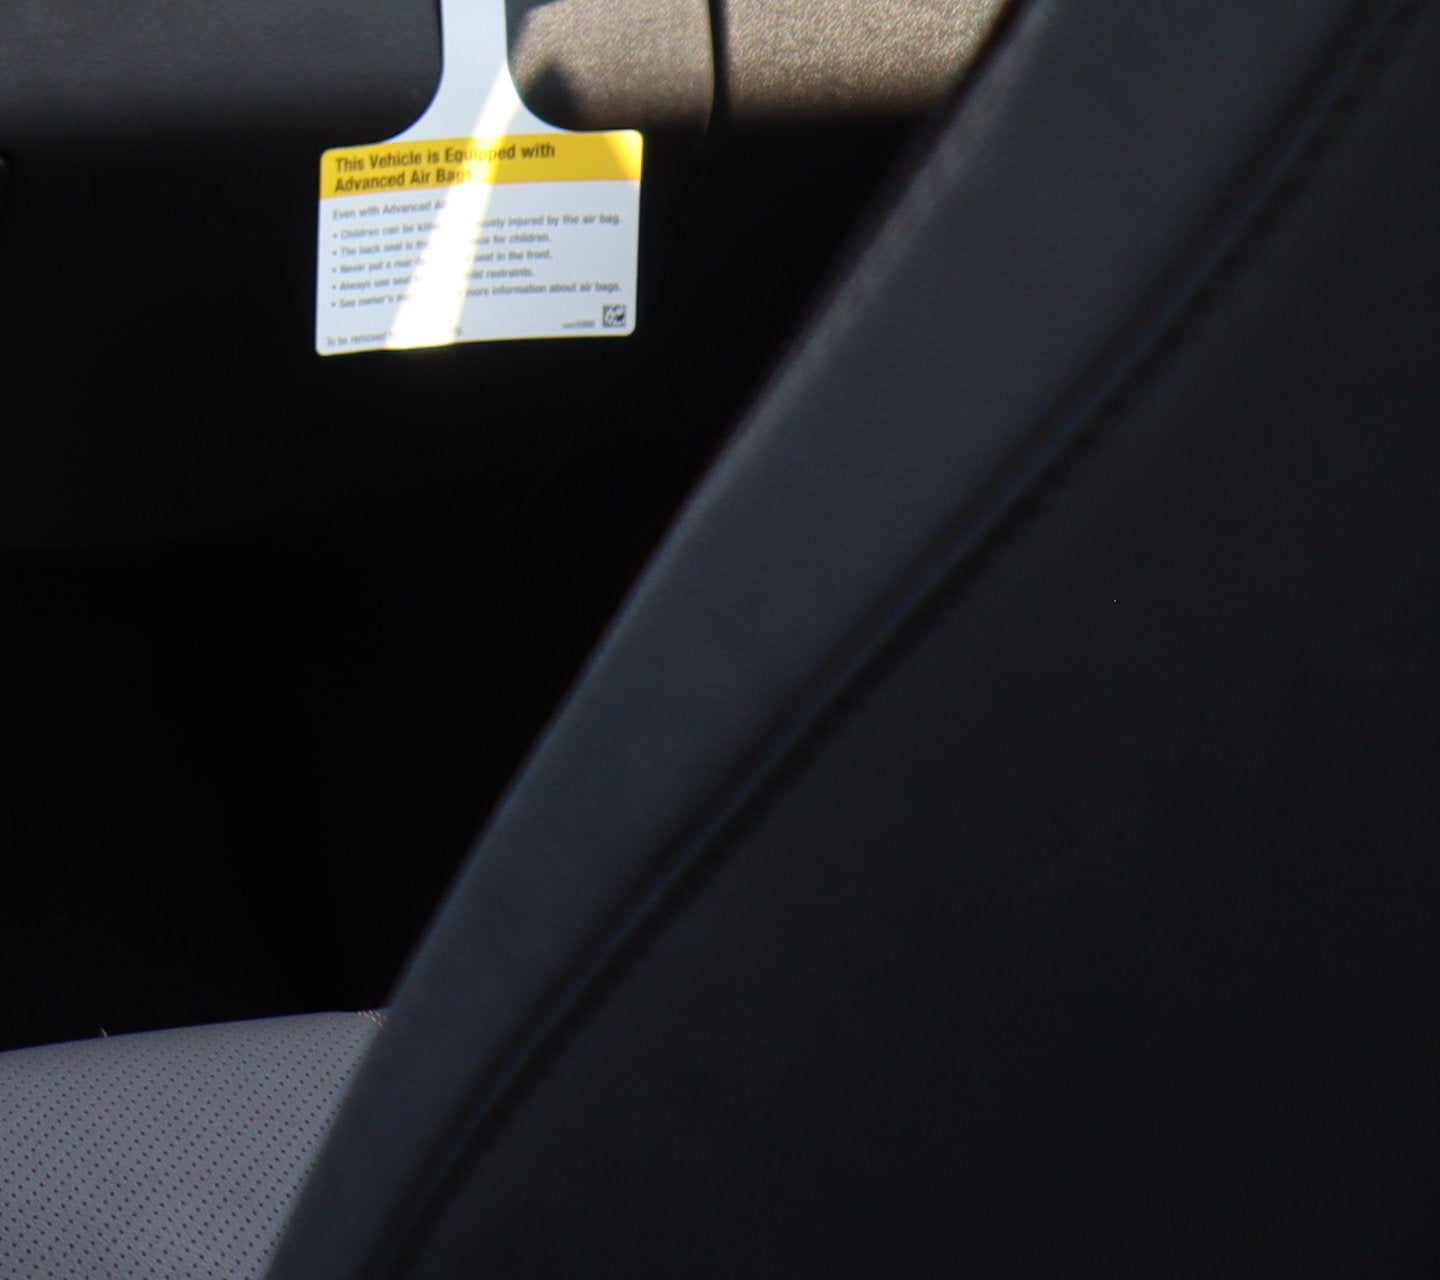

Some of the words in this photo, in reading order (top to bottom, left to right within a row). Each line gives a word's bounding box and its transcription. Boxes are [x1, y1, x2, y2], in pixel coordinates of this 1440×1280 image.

[335, 155, 365, 173] This
[369, 150, 422, 170] Vehicle
[427, 149, 440, 163] is
[521, 142, 555, 159] with
[335, 171, 405, 193] Advanced
[411, 170, 432, 185] Air
